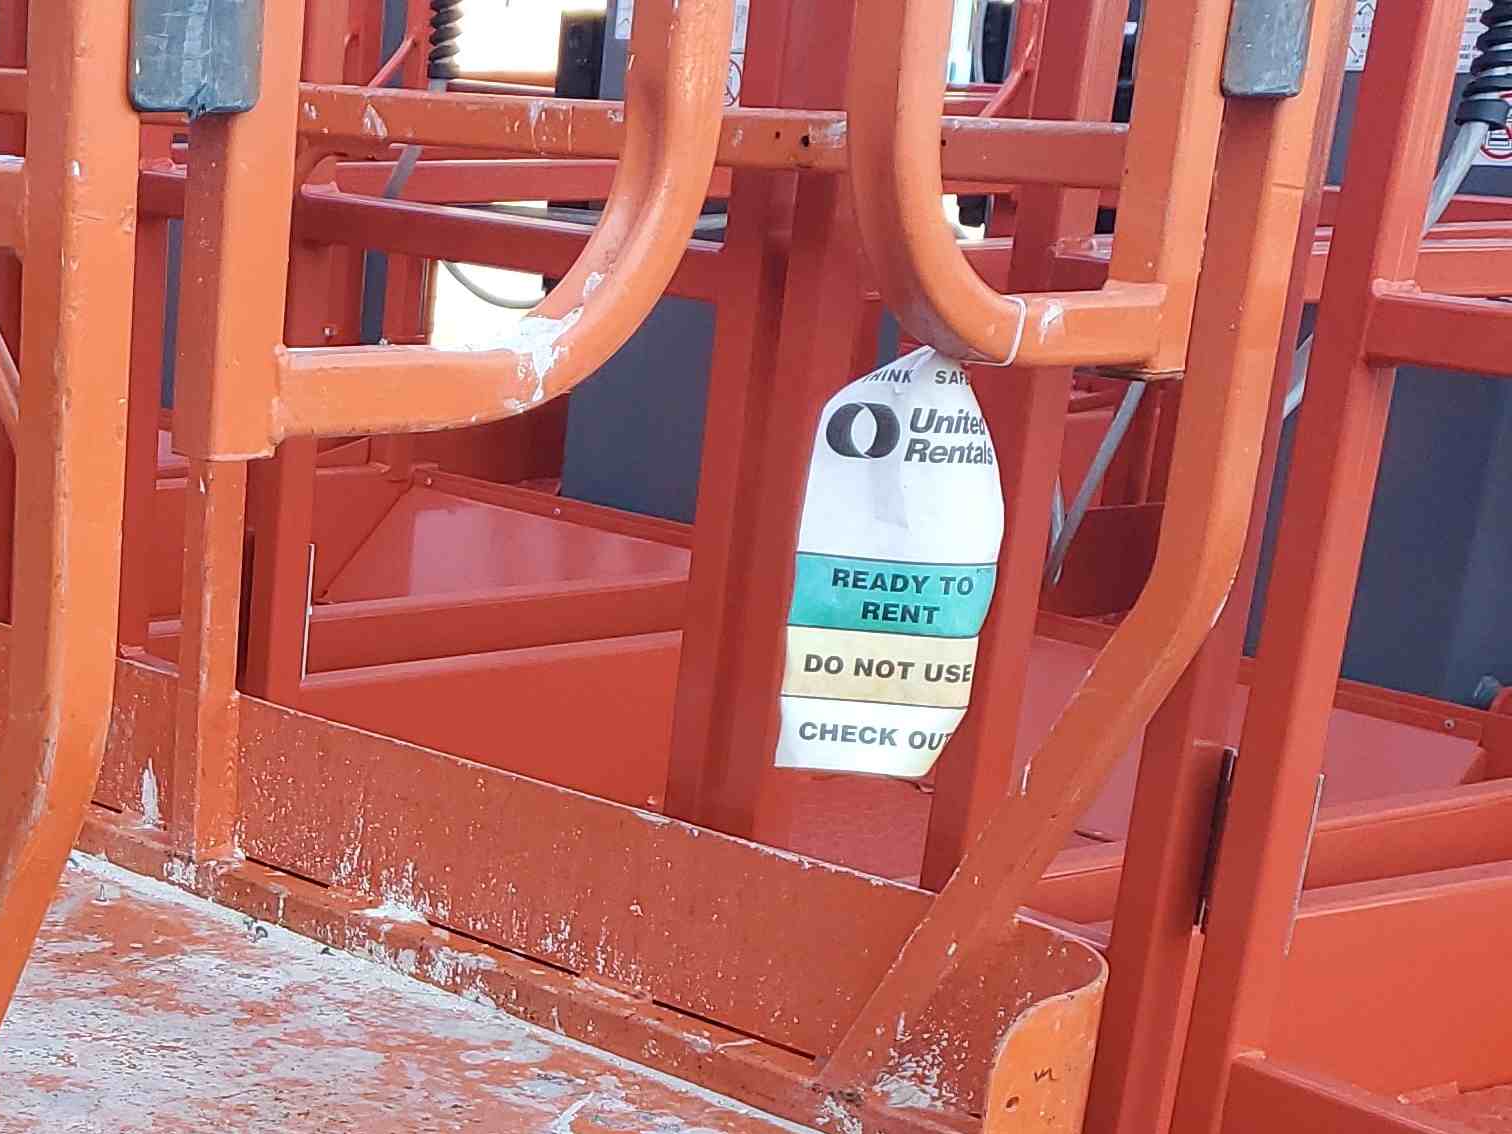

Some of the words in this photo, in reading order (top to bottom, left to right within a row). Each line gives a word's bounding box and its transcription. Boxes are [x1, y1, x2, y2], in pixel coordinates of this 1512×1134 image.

[863, 369, 913, 384] HINK
[904, 437, 993, 465] Rentals
[831, 567, 931, 594] READY
[939, 575, 974, 595] TO
[861, 601, 941, 625] RENT
[803, 653, 844, 675] DO
[853, 657, 915, 680] NOT
[924, 662, 972, 684] USE
[798, 721, 900, 746] CHECK
